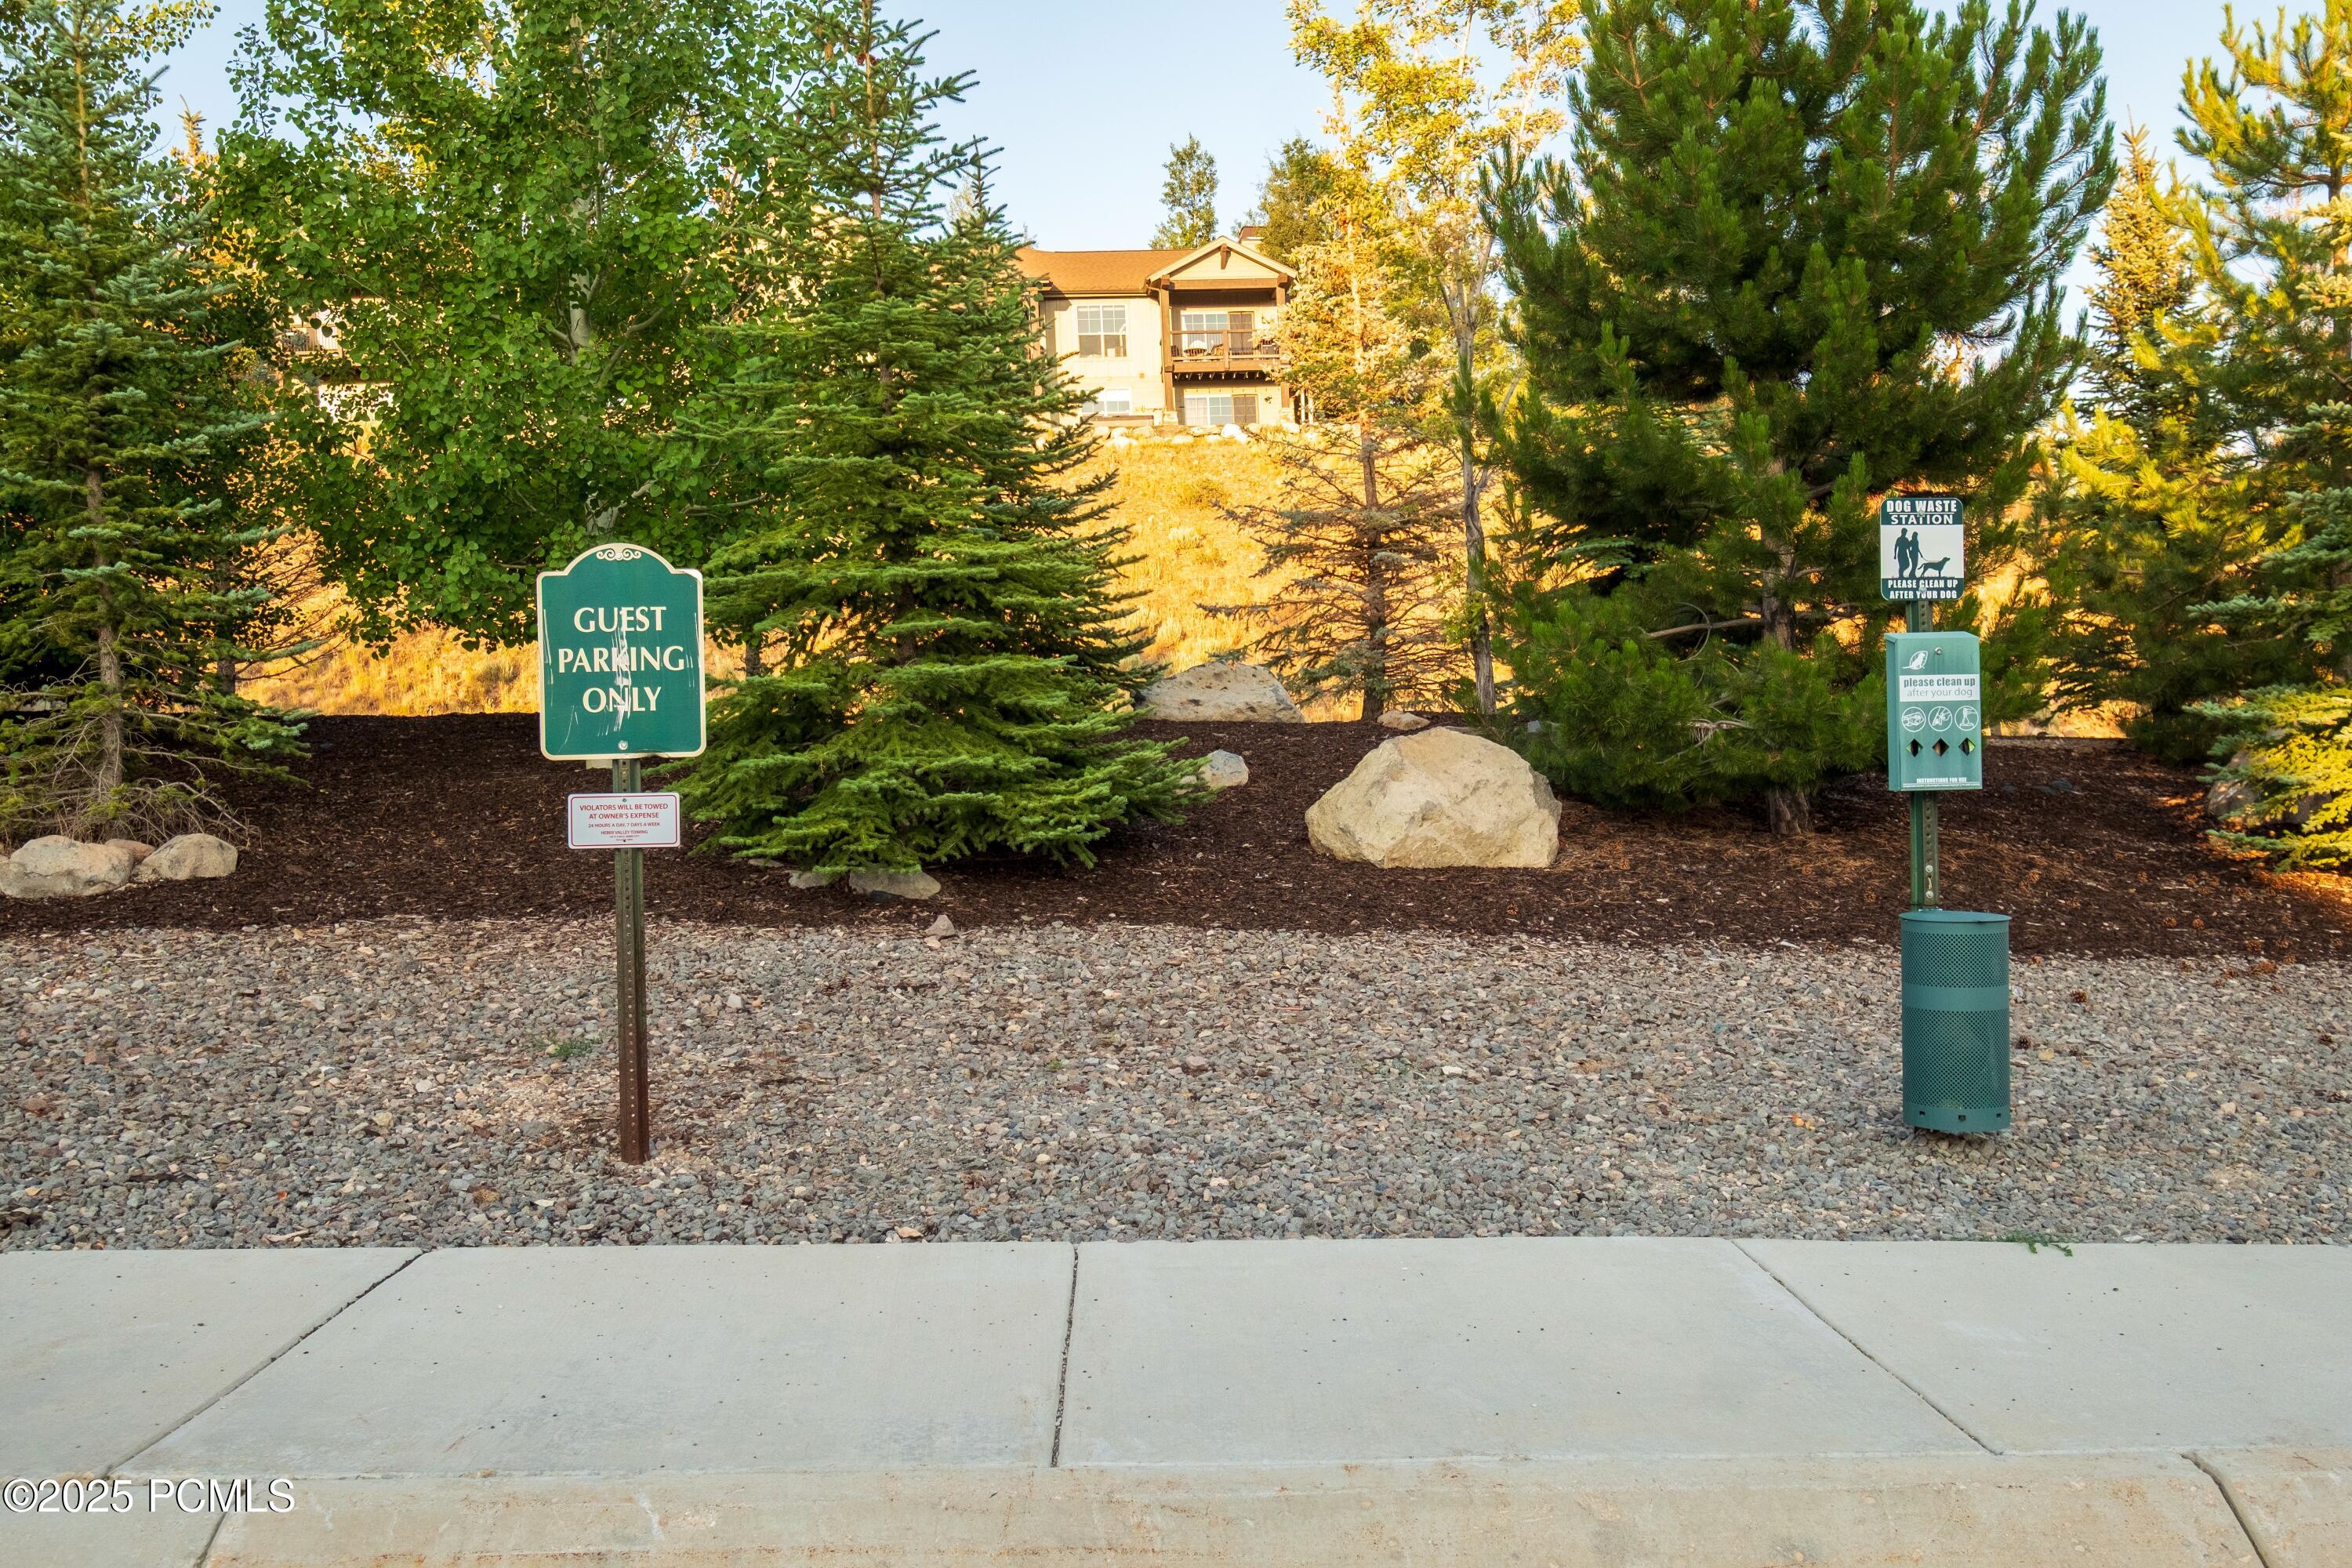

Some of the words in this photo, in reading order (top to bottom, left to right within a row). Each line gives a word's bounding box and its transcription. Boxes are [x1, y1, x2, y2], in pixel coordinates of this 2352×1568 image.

[1886, 500, 1911, 512] DOG
[1915, 500, 1957, 512] WASTE
[1891, 514, 1953, 524] STATION
[1919, 579, 1944, 588] CLEAN
[1947, 579, 1958, 588] UP
[1889, 590, 1914, 599] AFTER
[1916, 590, 1938, 599] YOUR
[1940, 590, 1958, 599] DOG
[573, 606, 666, 633] GUEST
[557, 645, 684, 673] PARKING
[1904, 678, 1934, 688] please
[1936, 677, 1962, 687] clean
[1964, 678, 1976, 687] up
[1907, 688, 1929, 697] after
[1931, 689, 1953, 699] your
[1955, 688, 1973, 697] dog
[582, 687, 662, 713] ONLY
